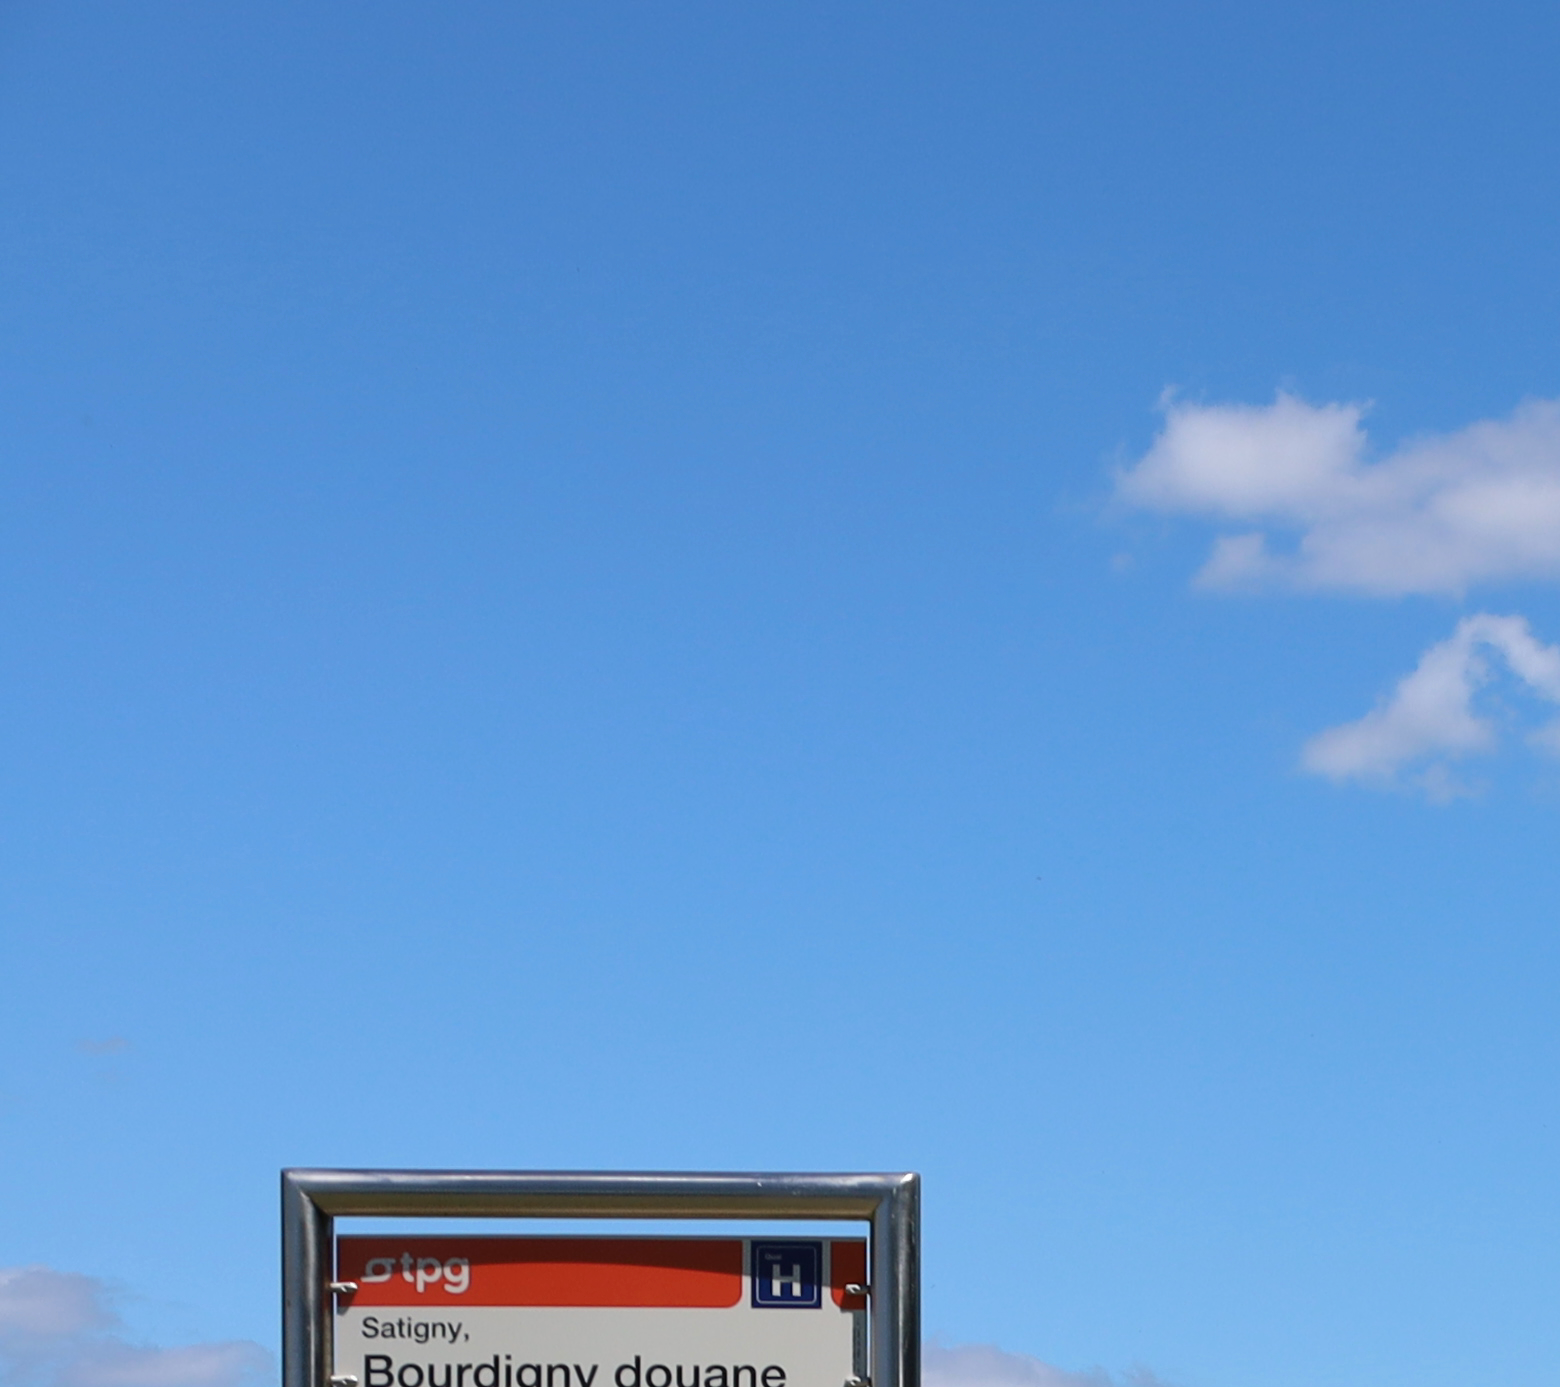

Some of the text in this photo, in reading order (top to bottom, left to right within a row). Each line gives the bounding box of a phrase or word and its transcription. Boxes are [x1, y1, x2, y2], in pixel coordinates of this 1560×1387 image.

[400, 1250, 471, 1294] tpg
[772, 1264, 802, 1298] H
[361, 1316, 471, 1343] Satigny,
